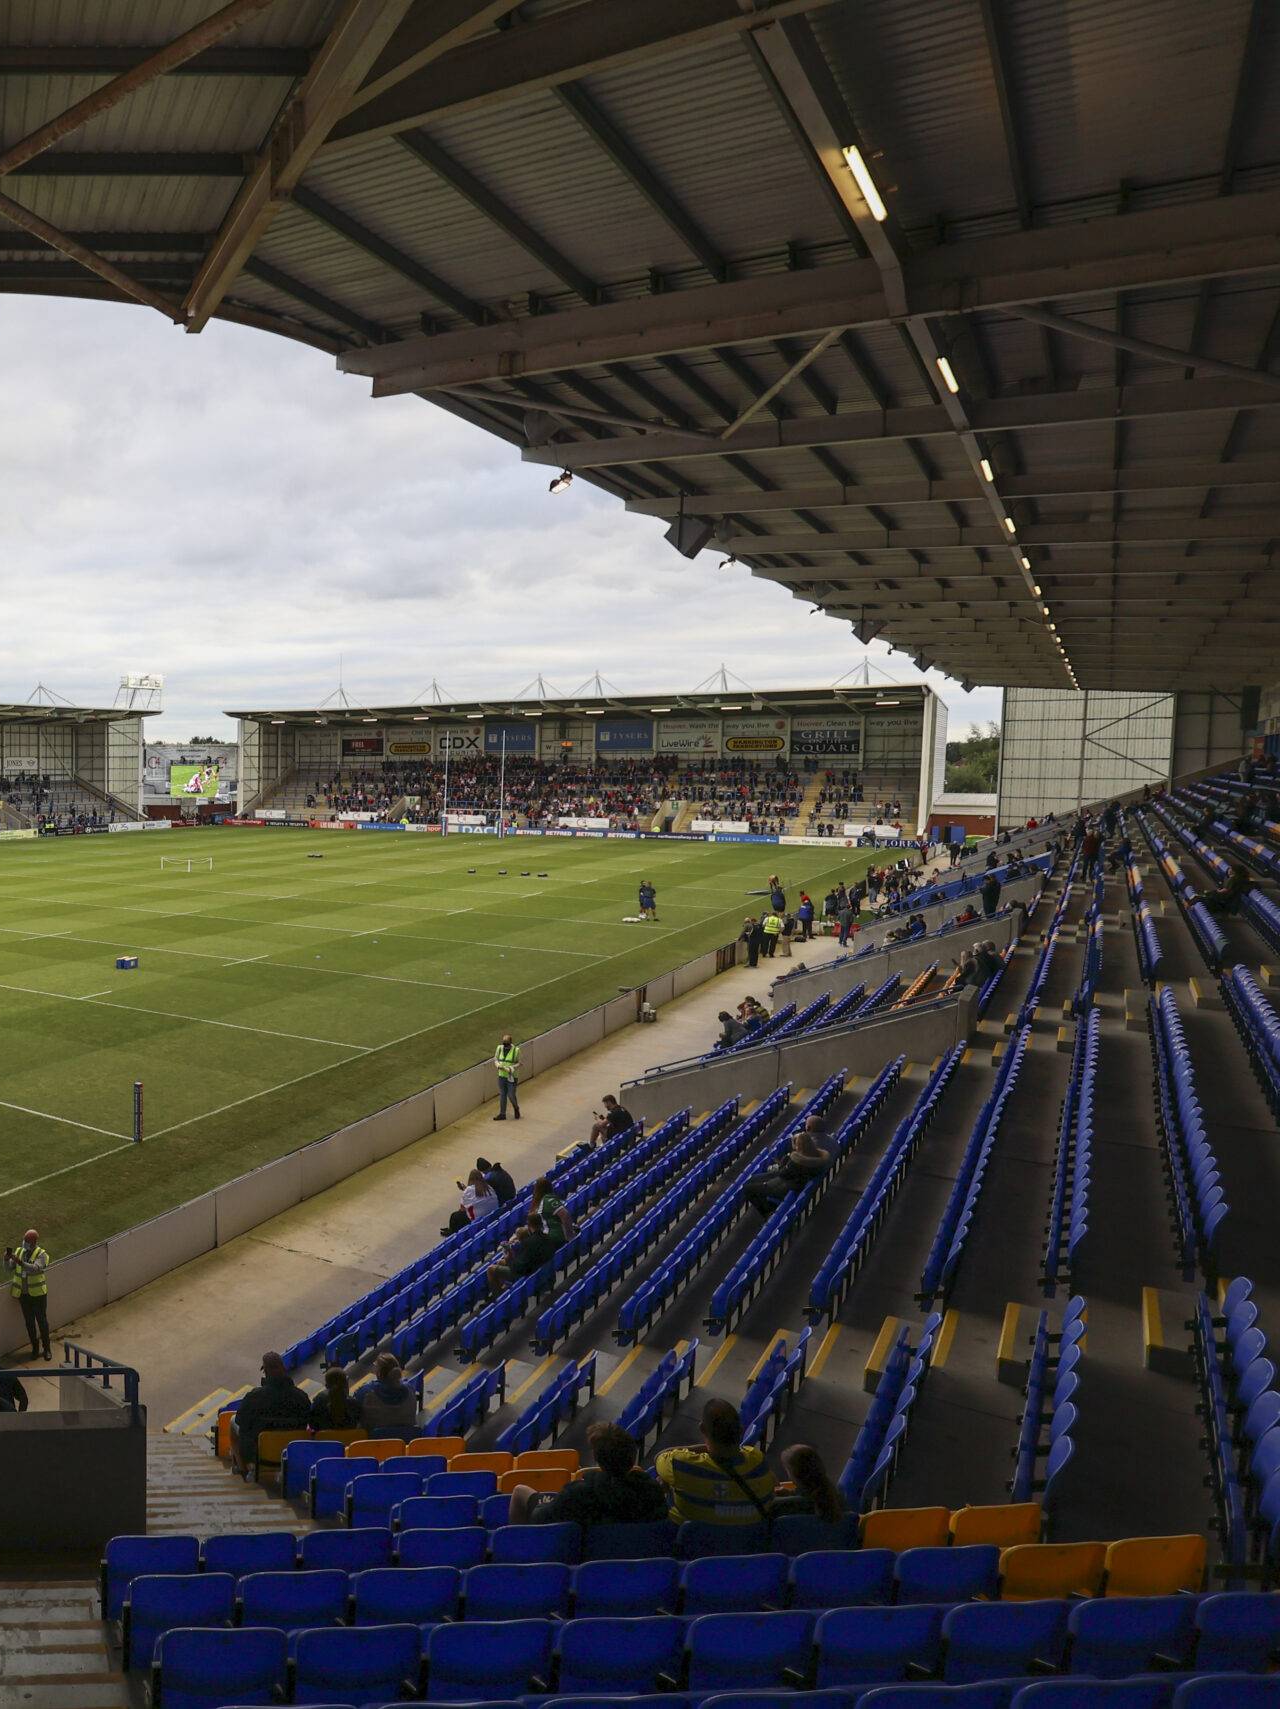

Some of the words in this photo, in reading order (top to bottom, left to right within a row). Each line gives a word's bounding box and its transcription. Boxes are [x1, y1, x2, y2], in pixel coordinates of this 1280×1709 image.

[801, 730, 850, 739] GRILL
[440, 737, 479, 749] CDX
[661, 739, 700, 748] LiveWire
[793, 743, 859, 753] SQUARE
[462, 825, 499, 834] DACI
